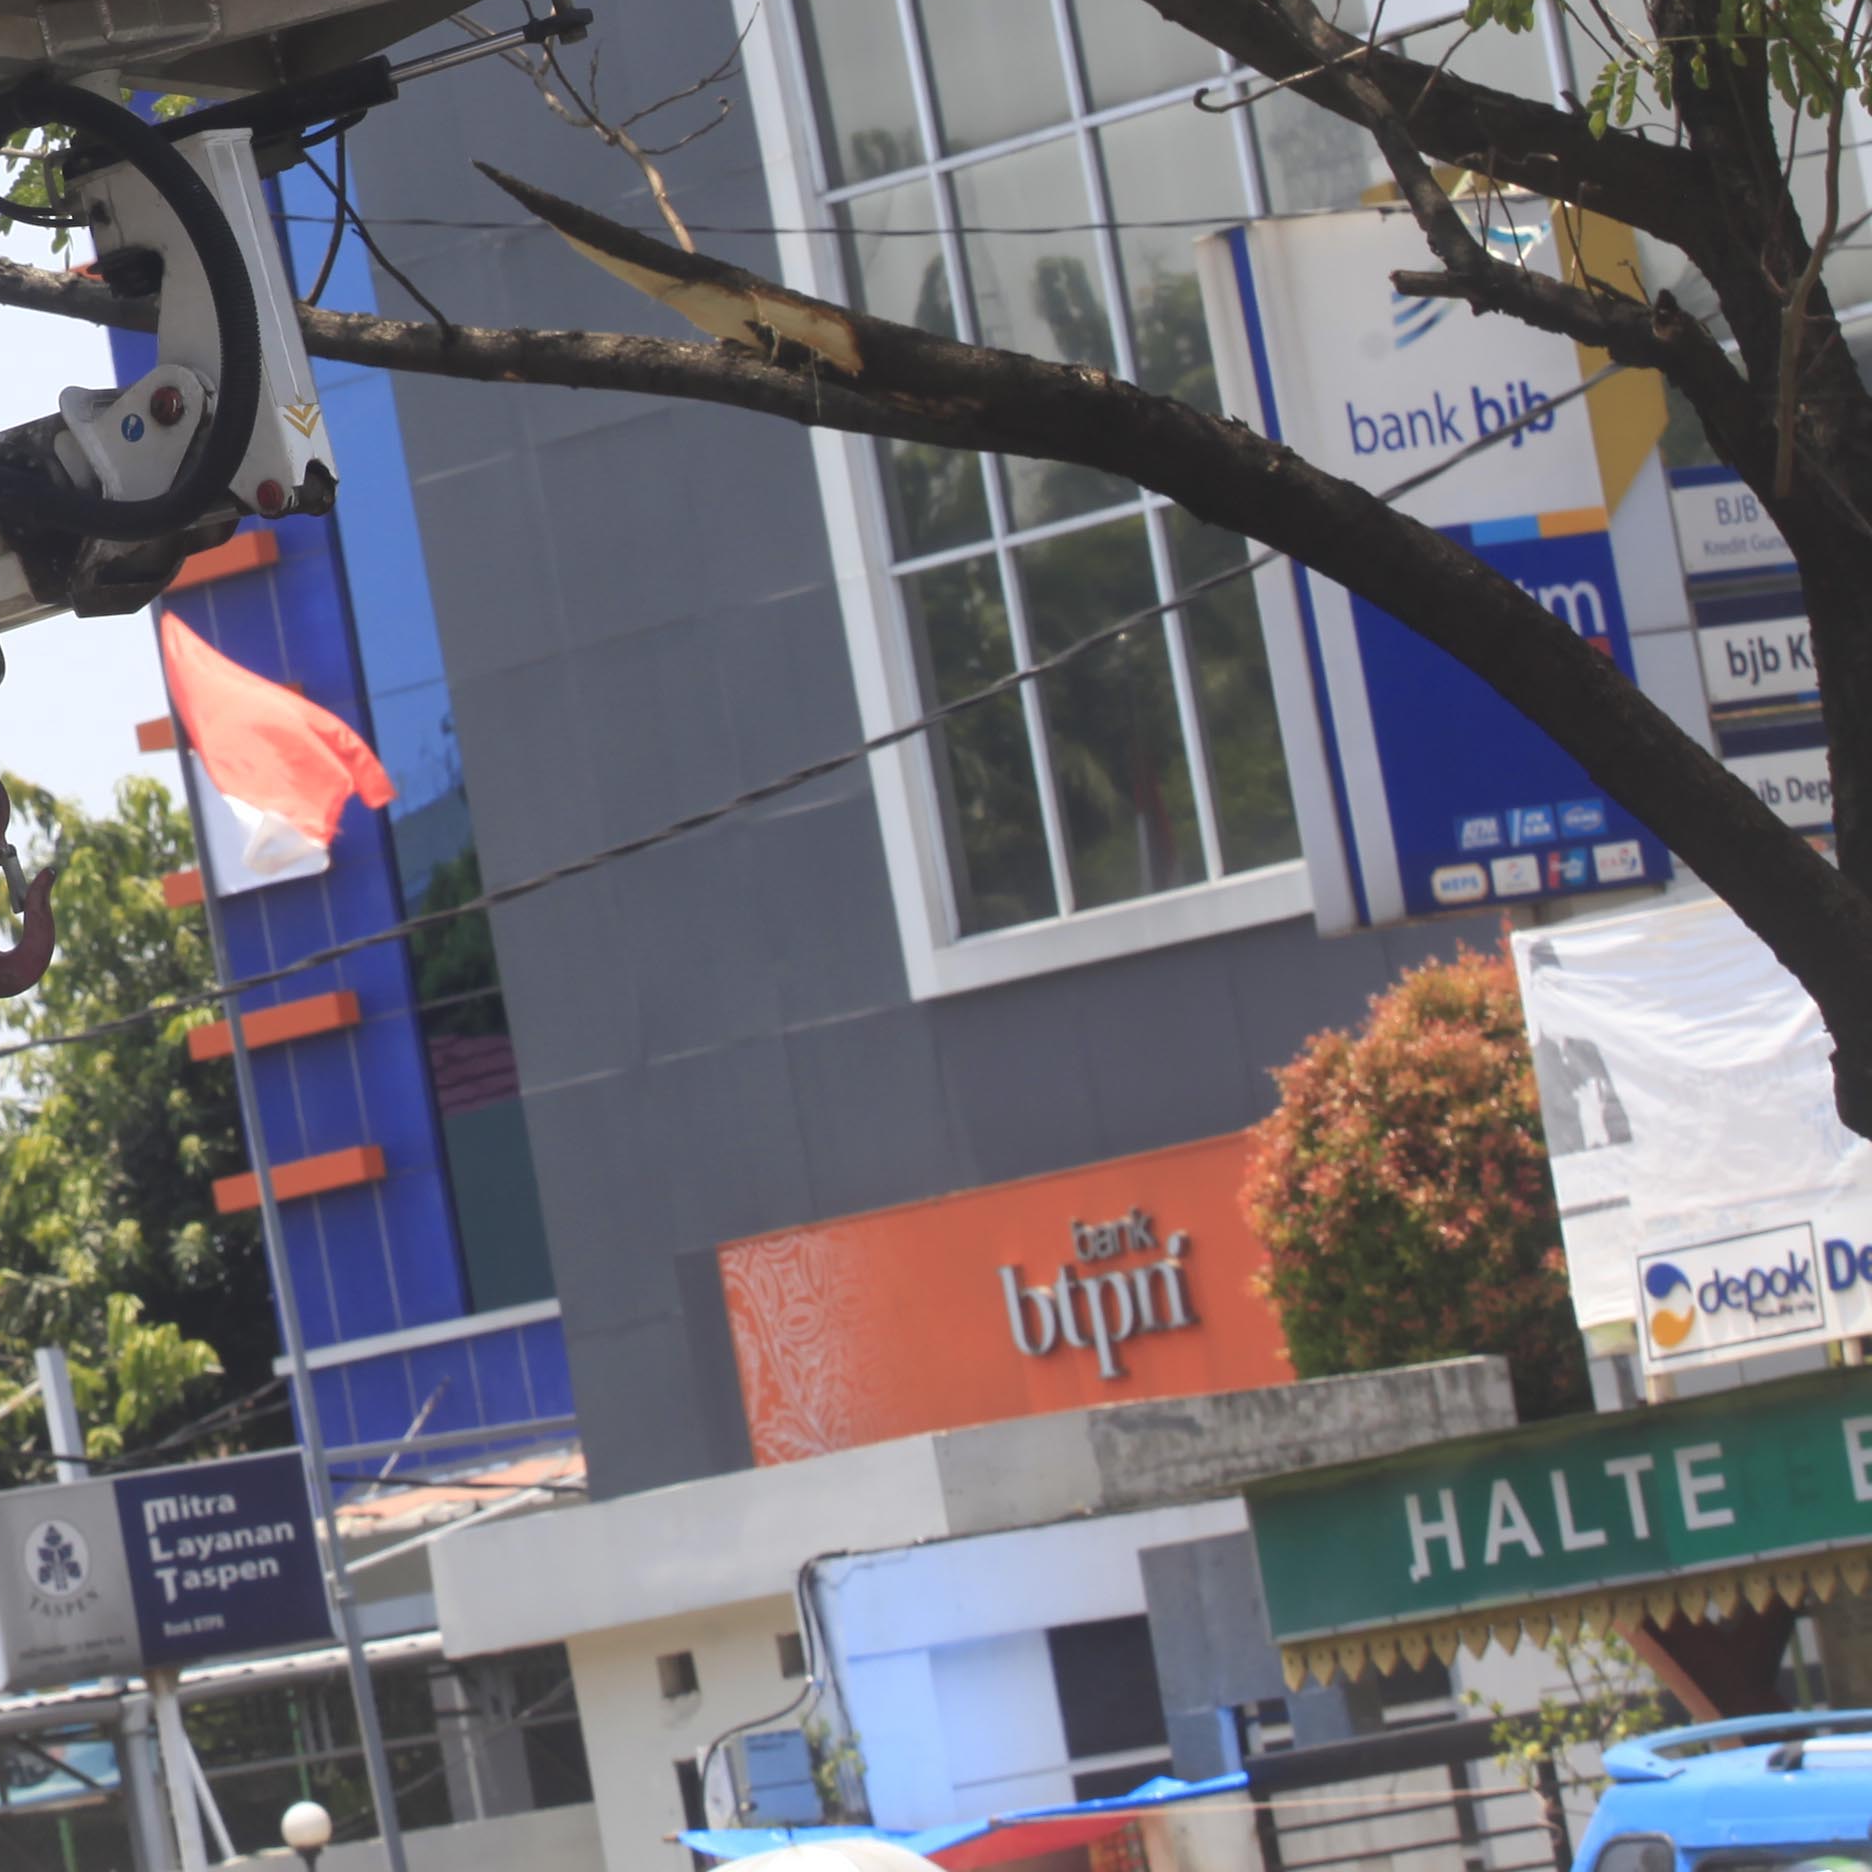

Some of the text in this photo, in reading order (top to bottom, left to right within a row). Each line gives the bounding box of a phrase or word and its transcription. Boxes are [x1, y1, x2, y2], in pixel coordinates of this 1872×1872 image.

[1346, 380, 1555, 455] bank bjb
[1715, 494, 1759, 525] BJB
[1726, 636, 1781, 685] bjb
[1071, 1207, 1159, 1263] bank
[998, 1231, 1200, 1380] btpn
[1699, 1251, 1812, 1321] depok
[143, 1494, 237, 1533] Mitra
[1405, 1442, 1735, 1582] HALTE
[149, 1521, 295, 1562] Layanan
[29, 1588, 99, 1616] TASPEN
[154, 1558, 280, 1604] Taspen
